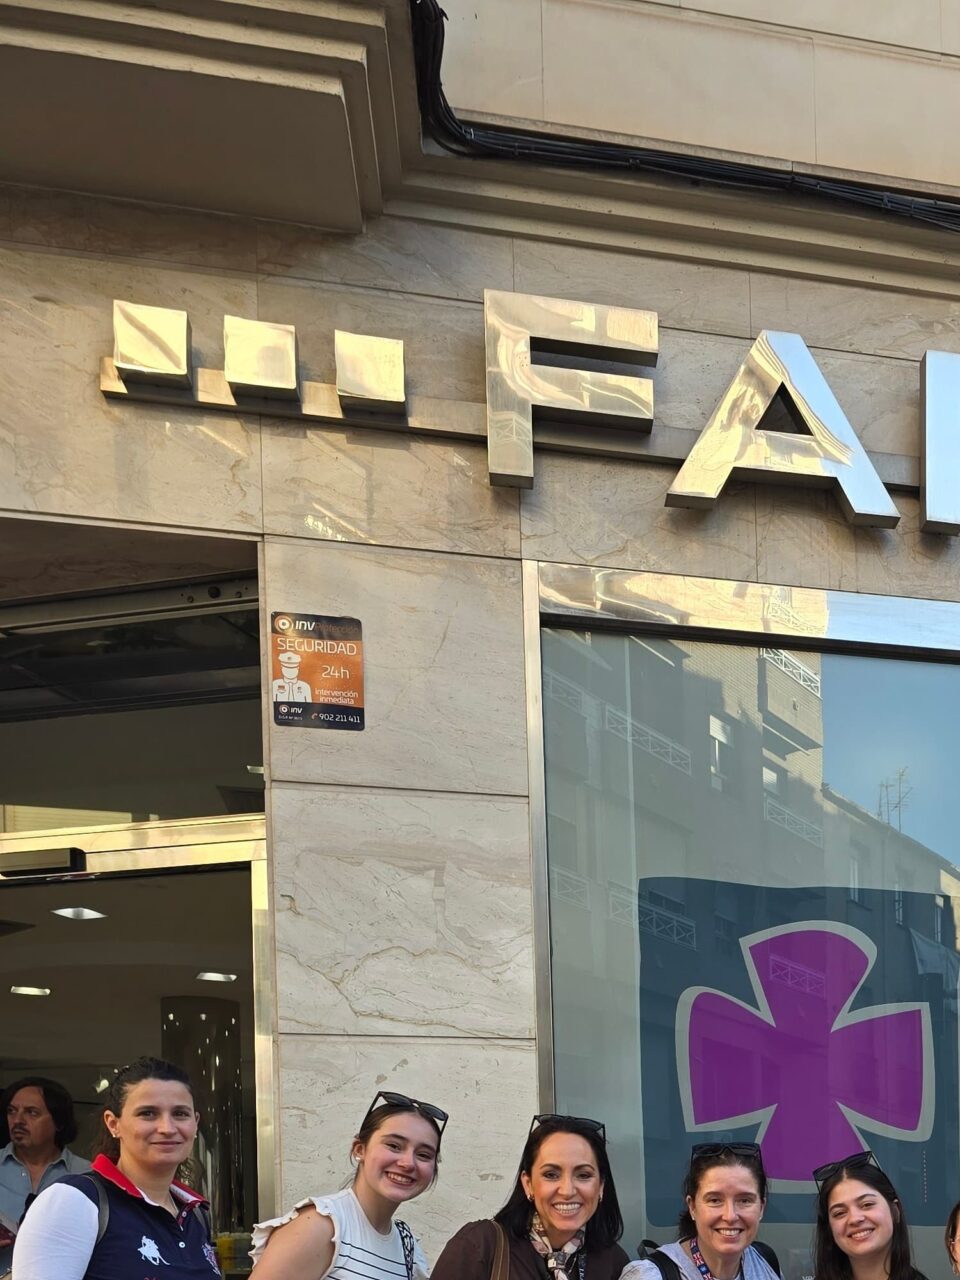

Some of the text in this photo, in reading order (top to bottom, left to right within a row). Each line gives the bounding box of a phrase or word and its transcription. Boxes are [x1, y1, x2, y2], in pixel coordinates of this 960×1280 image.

[277, 638, 357, 656] SEGURIDAD
[321, 665, 350, 679] 24h
[319, 713, 334, 721] 902
[335, 714, 347, 722] 211
